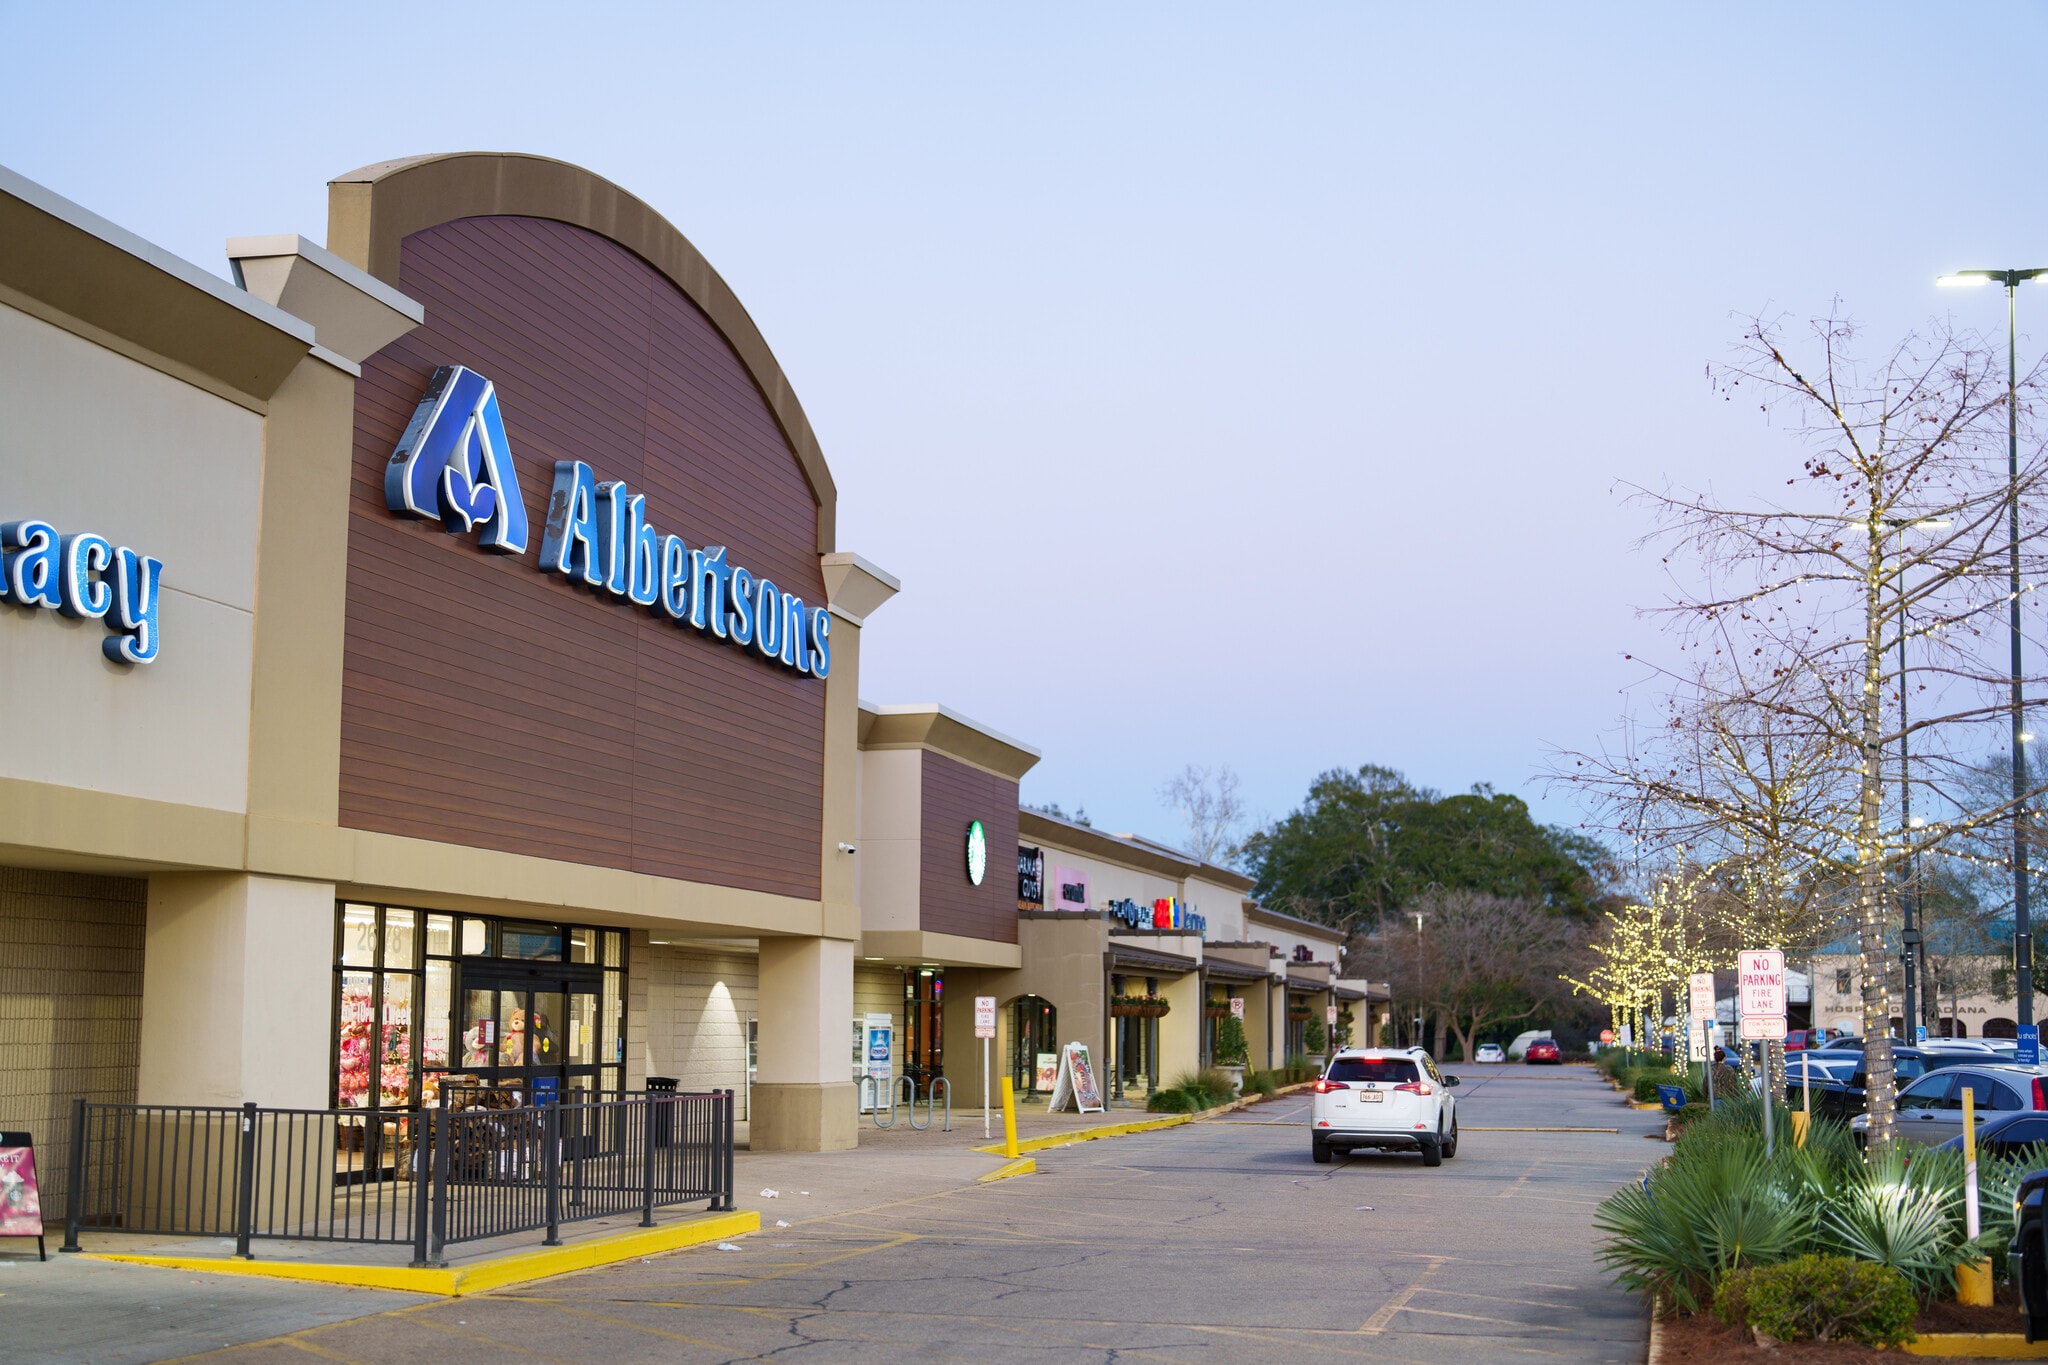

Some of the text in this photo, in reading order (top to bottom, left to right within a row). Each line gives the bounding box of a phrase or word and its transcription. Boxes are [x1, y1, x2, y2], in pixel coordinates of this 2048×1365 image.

[546, 460, 831, 680] Albertsons
[0, 519, 163, 664] acy
[1753, 958, 1769, 971] NO
[1743, 974, 1781, 986] PARKING
[1752, 989, 1772, 997] FIRE
[1751, 1000, 1774, 1009] LANE
[1825, 1006, 1870, 1014] HOSP
[10, 1154, 19, 1163] IT
